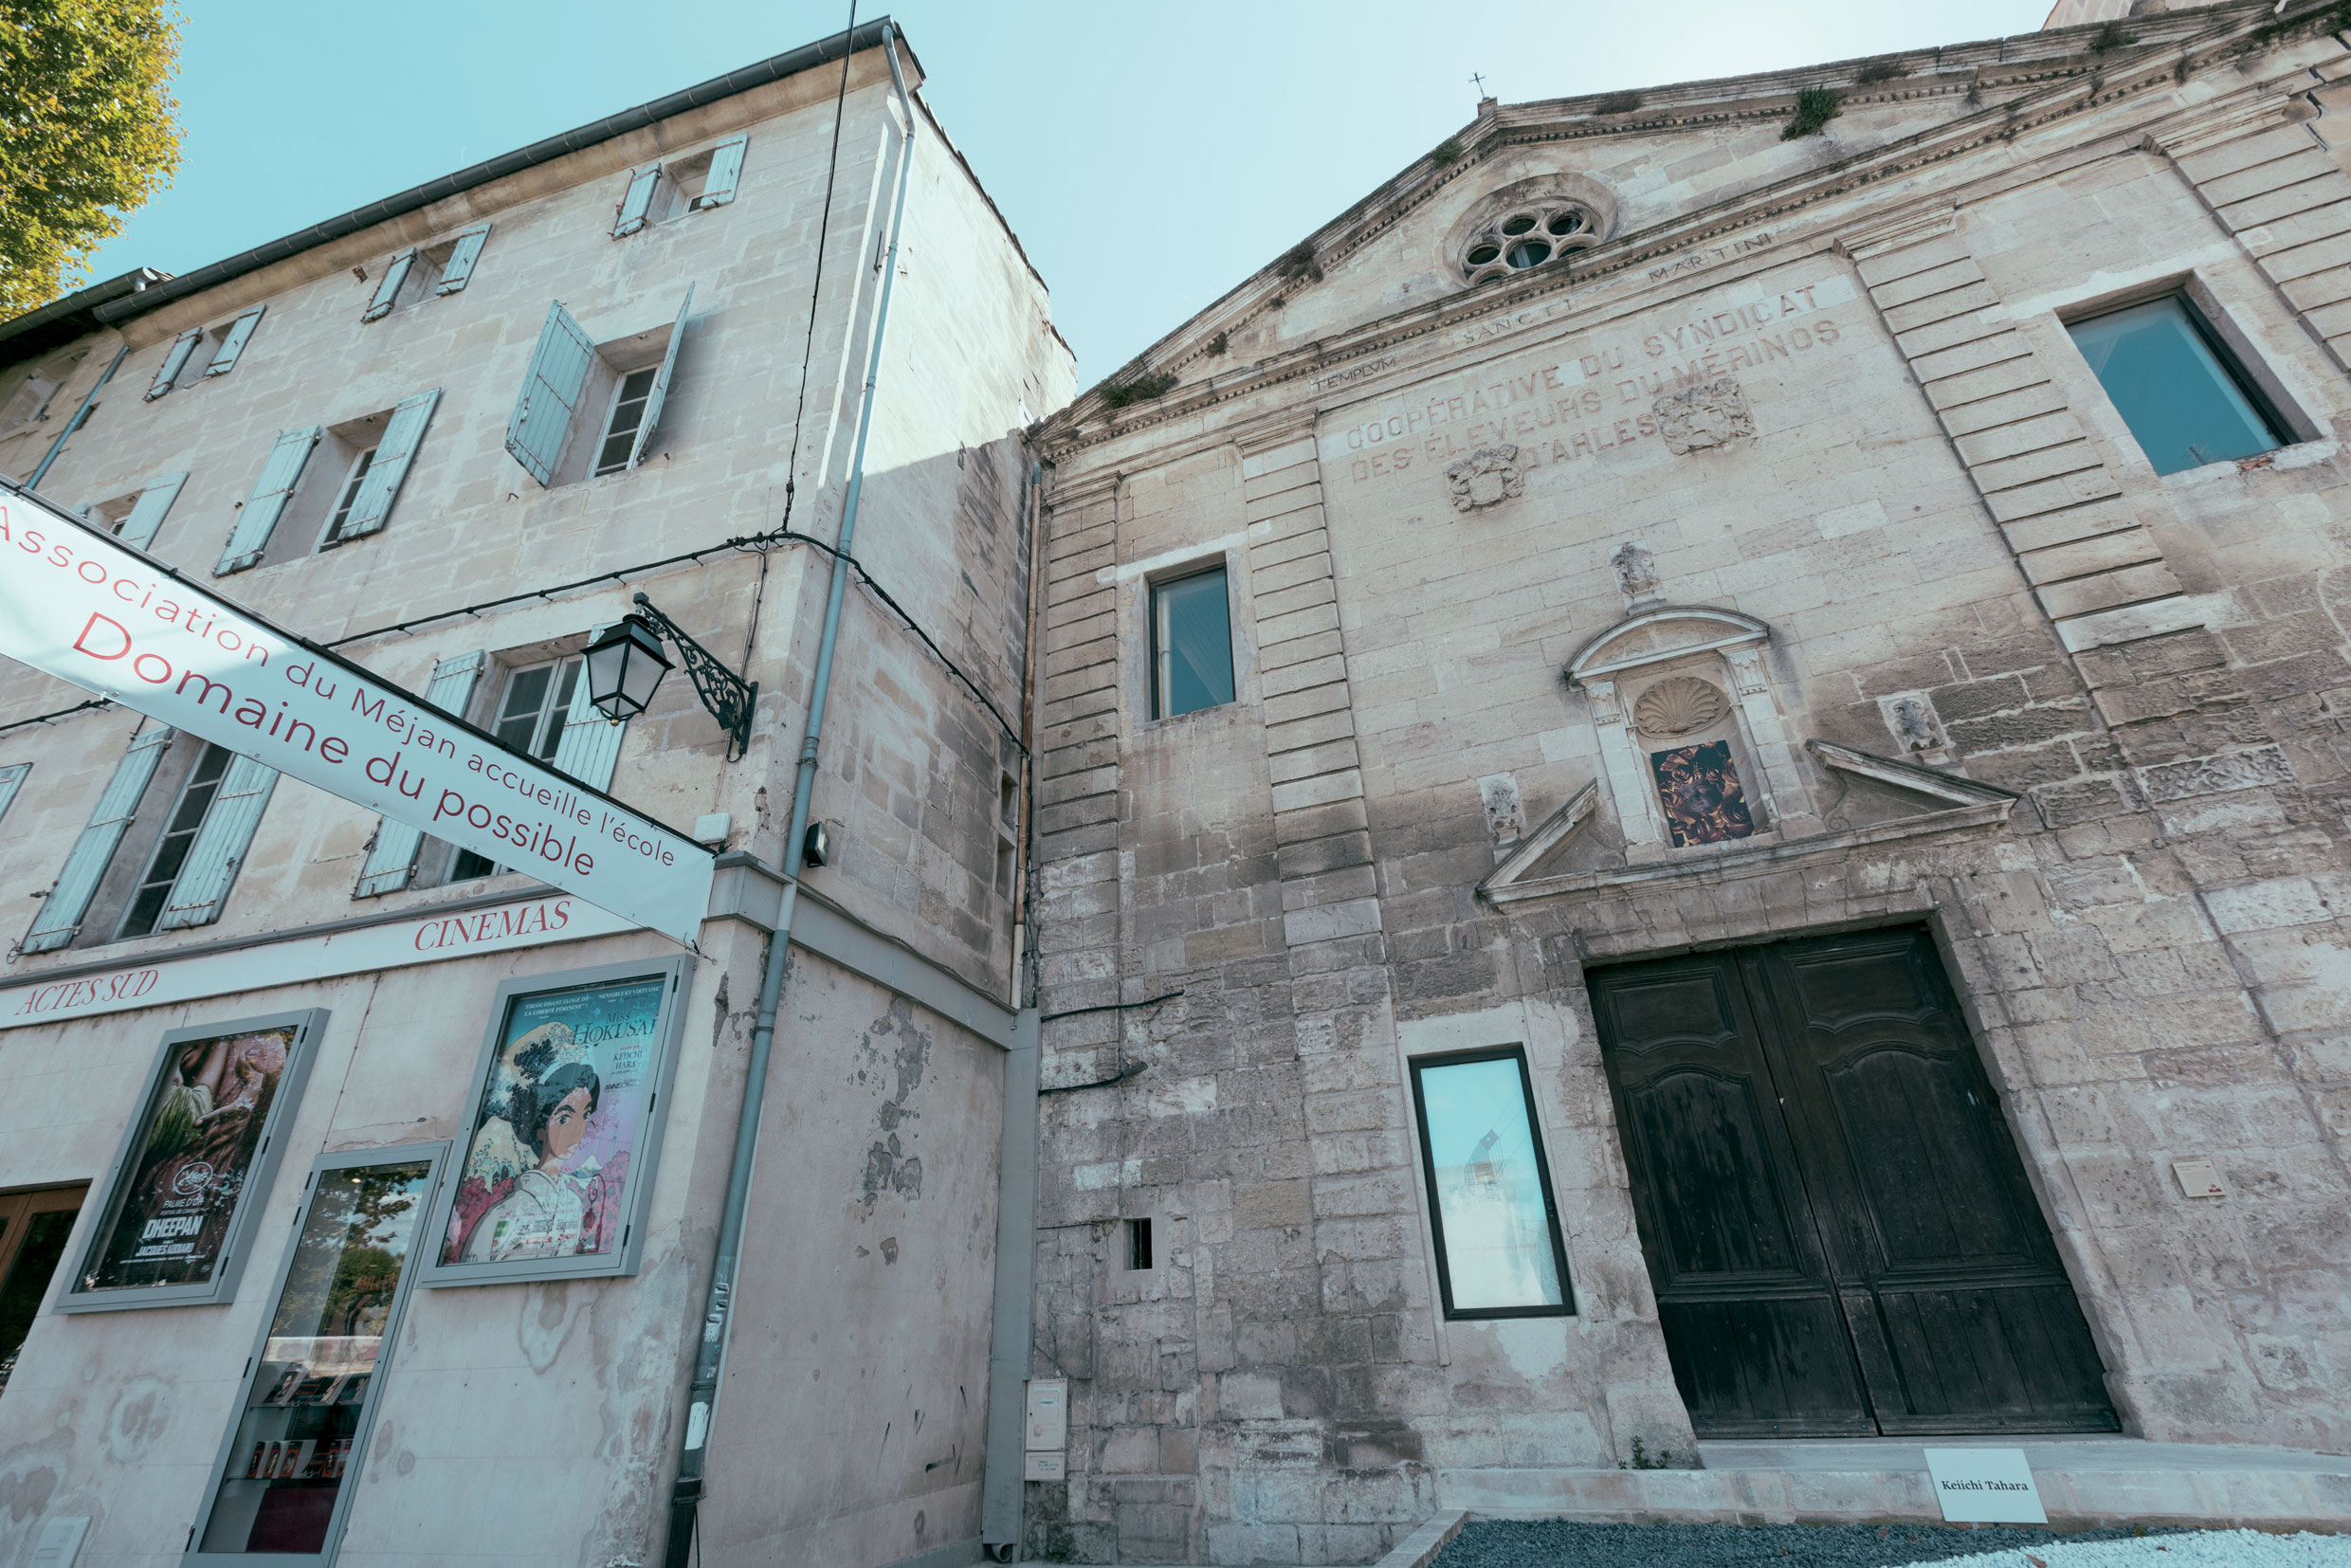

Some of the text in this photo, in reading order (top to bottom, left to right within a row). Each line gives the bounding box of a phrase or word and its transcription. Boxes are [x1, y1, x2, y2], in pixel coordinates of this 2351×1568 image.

[1464, 298, 1576, 345] SANCTI
[1648, 232, 1773, 284] MARTINI
[1347, 285, 1817, 450] COOPÉRATIVE DU SYNDICAT
[1350, 319, 1841, 484] DES ÉLEVEURS DU MÉRINOS
[0, 505, 675, 867] Association du Méjan accueille l'école
[73, 611, 595, 876] Domaine du possible
[414, 900, 572, 952] CINEMAS
[14, 968, 159, 1017] ACTES SUD
[141, 1214, 205, 1240] DHEEPAN
[164, 1198, 186, 1209] PALME
[1941, 1480, 2029, 1491] Keiichi Tahara
